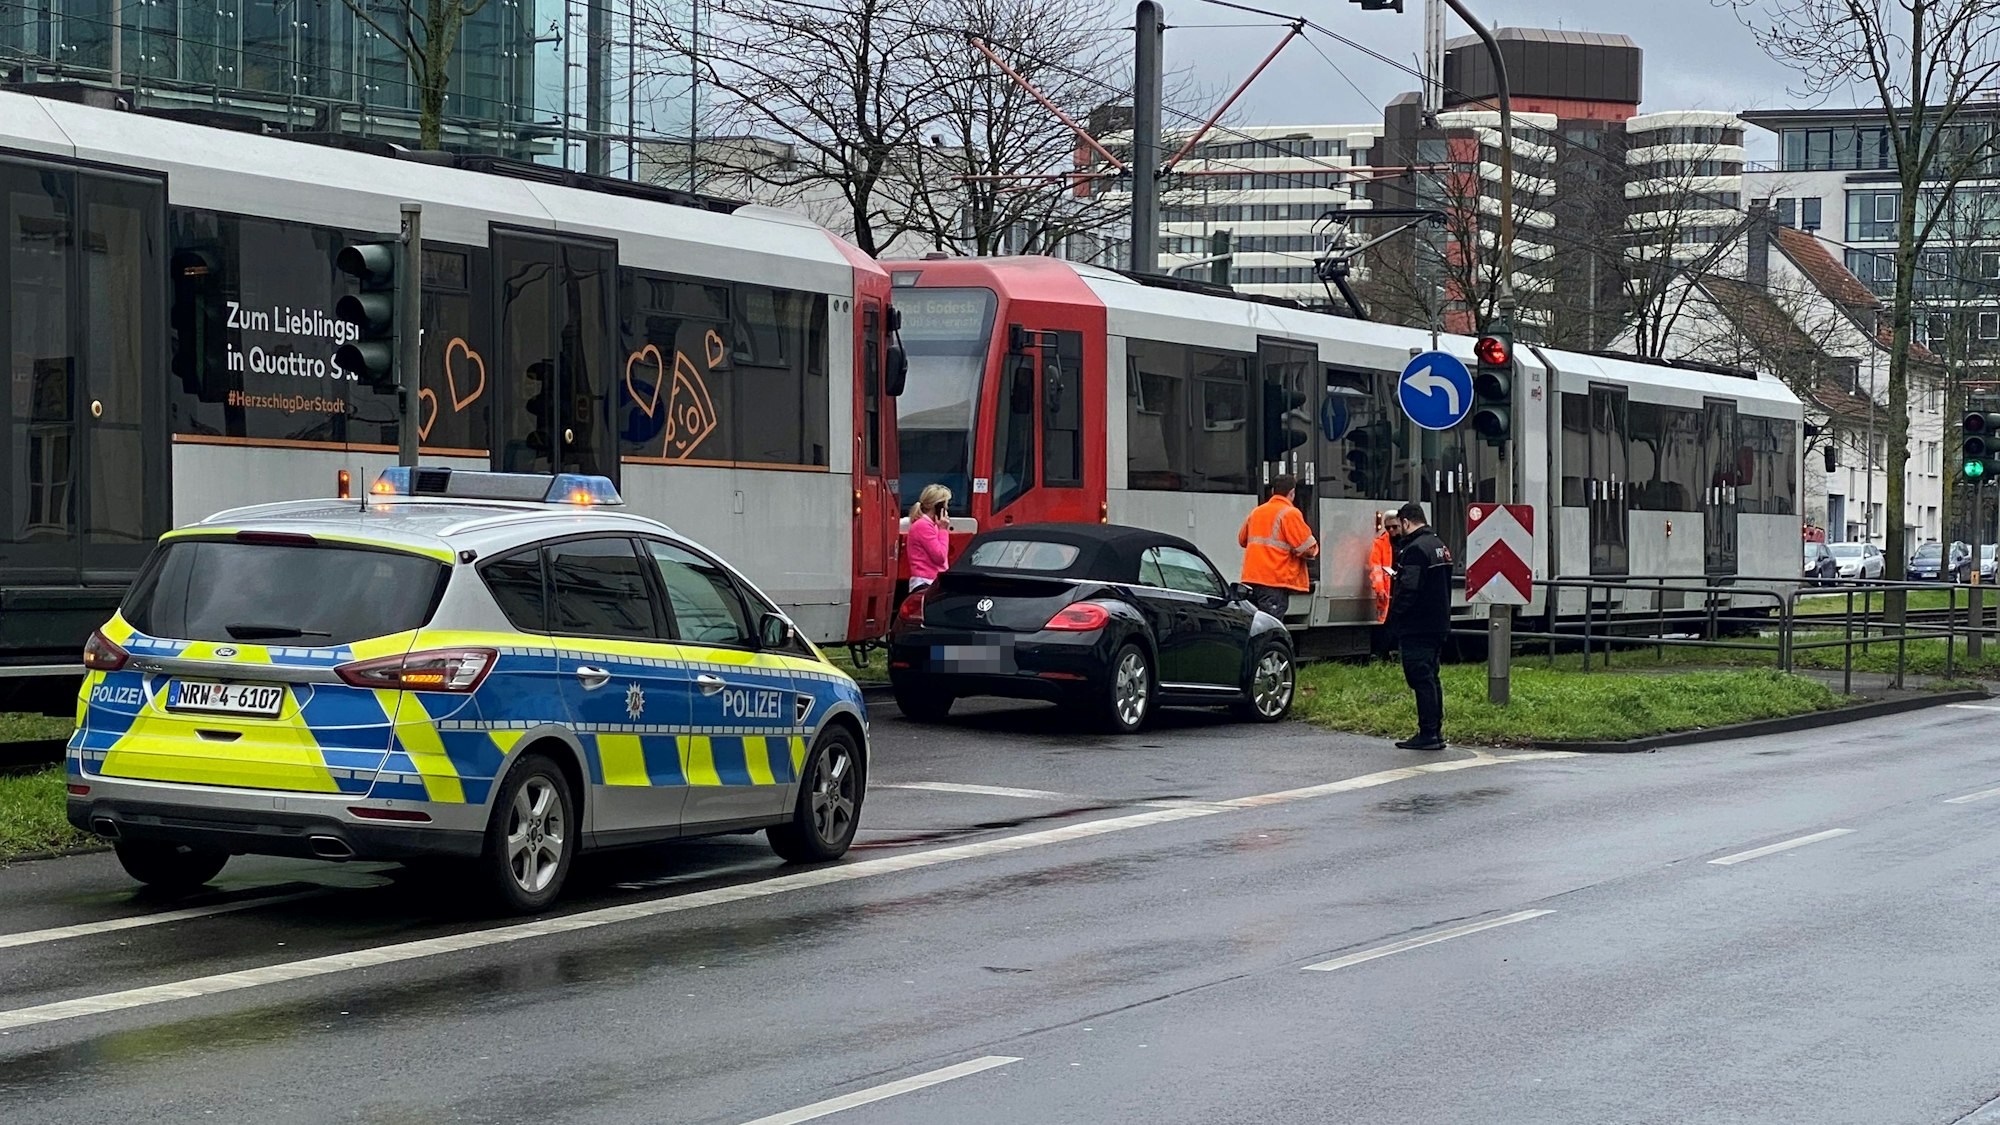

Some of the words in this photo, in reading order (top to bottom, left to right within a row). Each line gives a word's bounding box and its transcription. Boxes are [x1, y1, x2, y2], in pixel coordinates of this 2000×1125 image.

[227, 302, 268, 331] Zum
[227, 342, 244, 372] in
[250, 346, 325, 378] Quattro
[228, 390, 346, 414] #HerzschlagDerStadt
[91, 686, 143, 705] POLIZEI
[169, 695, 176, 703] D
[178, 684, 211, 705] NRW
[220, 687, 280, 709] 4-6107
[723, 690, 781, 718] POLIZEI
